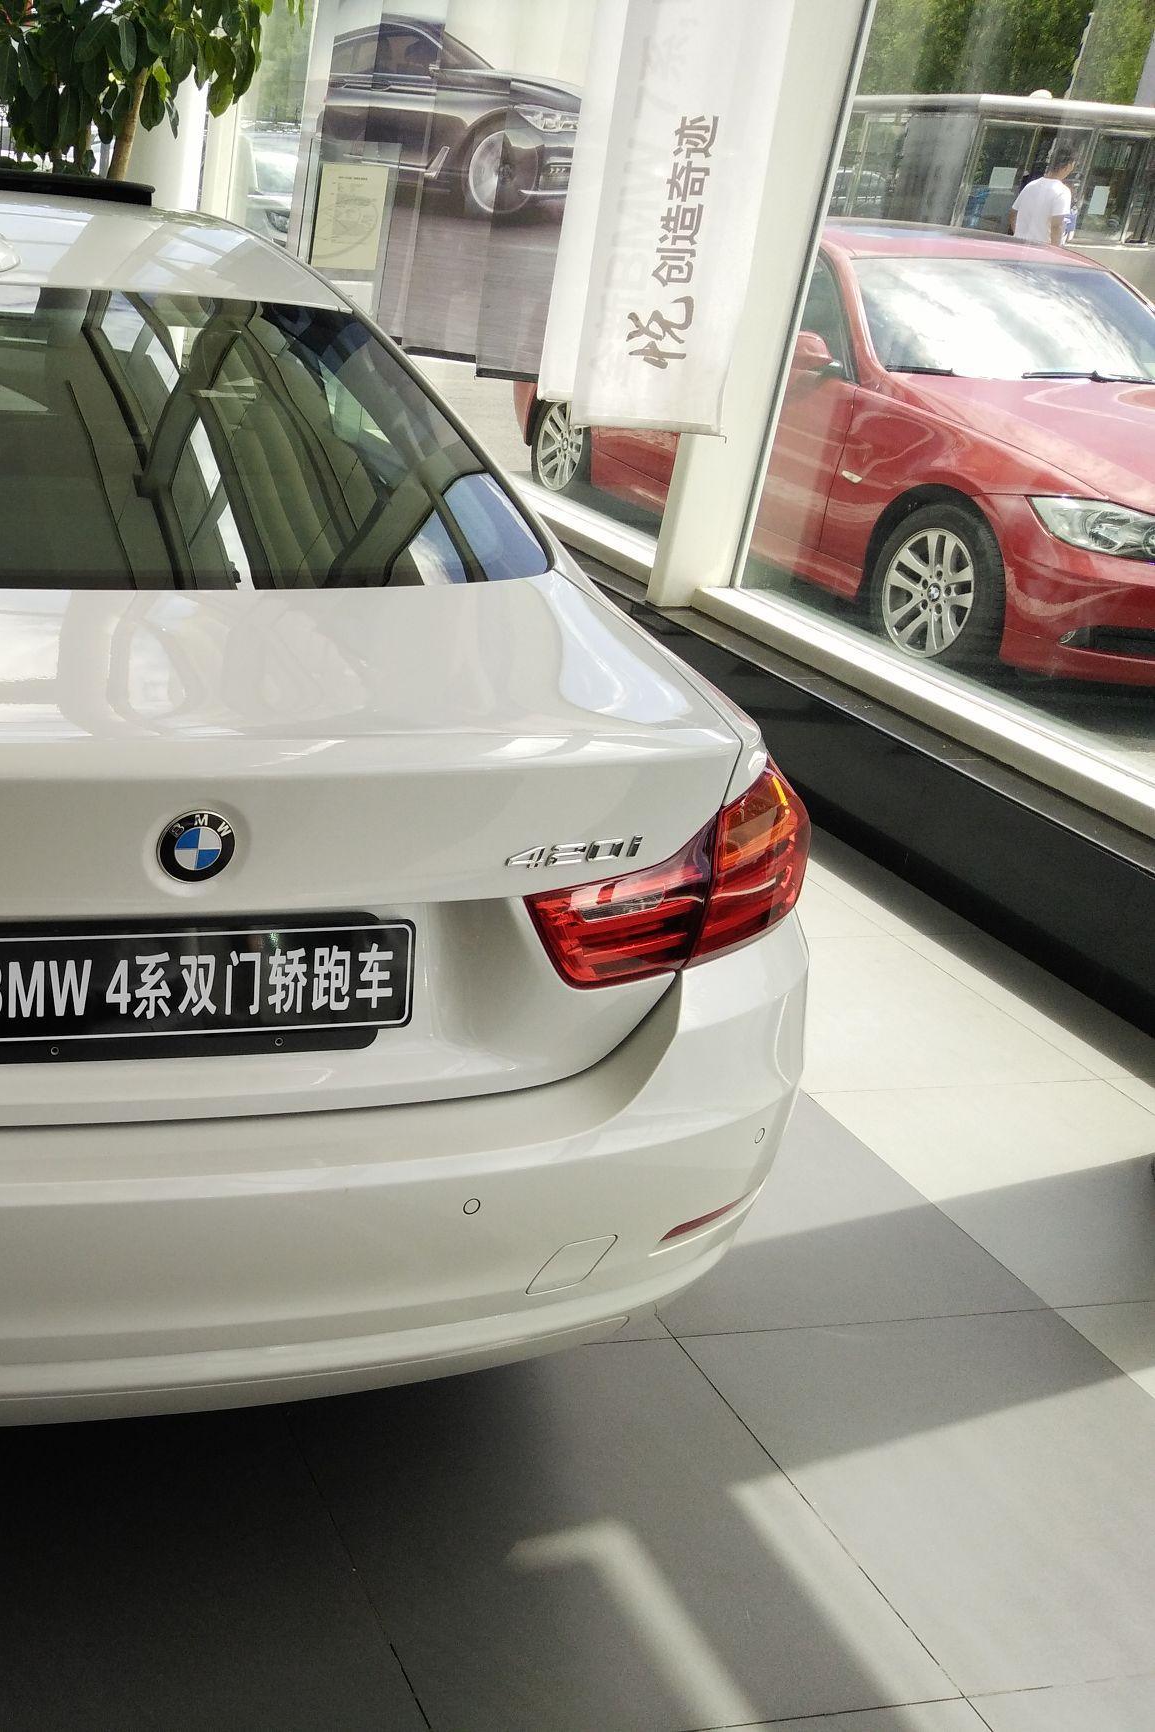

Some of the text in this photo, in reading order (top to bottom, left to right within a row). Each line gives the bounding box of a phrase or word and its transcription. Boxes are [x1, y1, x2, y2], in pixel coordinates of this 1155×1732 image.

[505, 835, 643, 869] 420i
[106, 942, 394, 1020] 4系双门轿跑车
